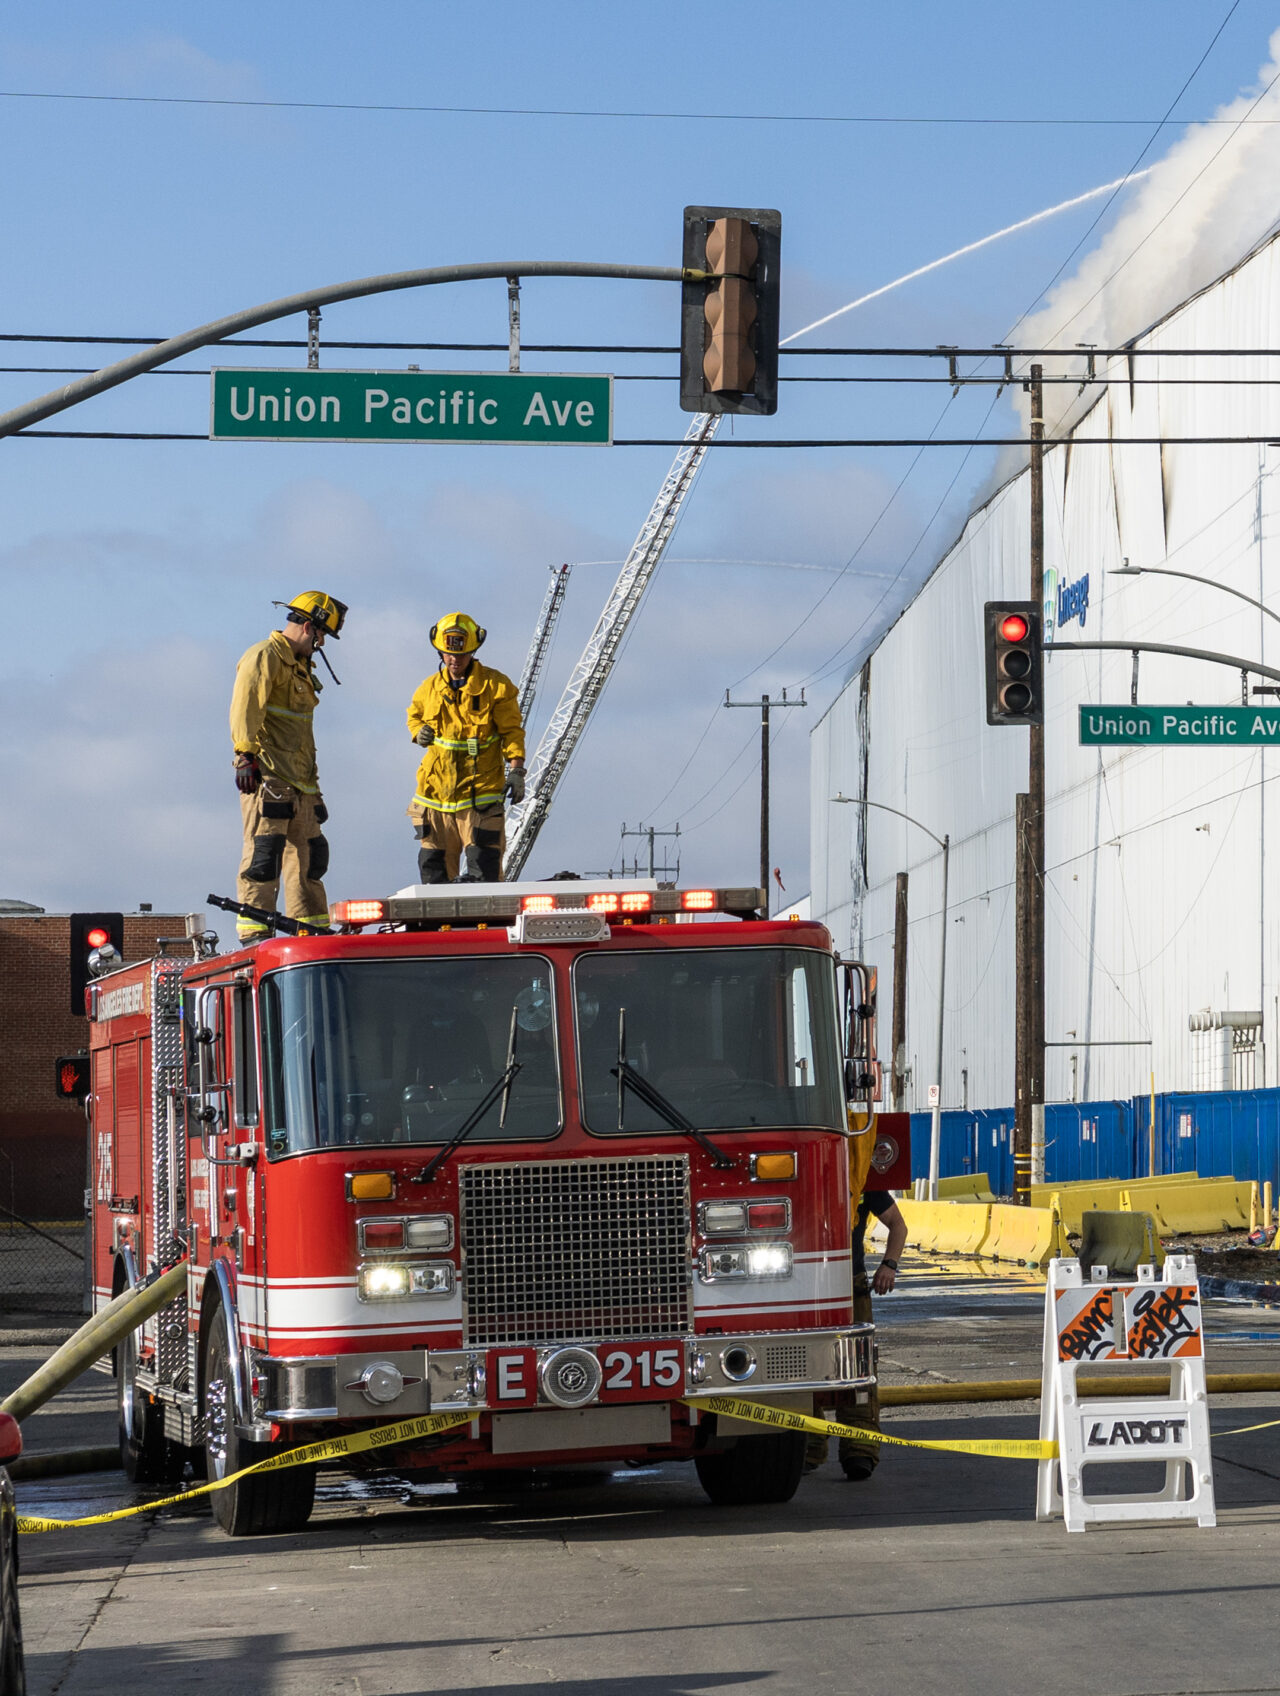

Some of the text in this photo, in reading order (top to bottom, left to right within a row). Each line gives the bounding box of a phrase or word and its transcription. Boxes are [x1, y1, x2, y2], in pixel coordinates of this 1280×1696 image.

[230, 386, 595, 427] Union Pacific Ave
[316, 607, 326, 620] 15
[448, 636, 460, 646] 15
[1089, 715, 1150, 735] Union
[1163, 715, 1237, 735] Pacific
[97, 1131, 113, 1202] 215
[499, 1349, 680, 1399] E 215
[709, 1398, 805, 1428] FIRE LINE DO NOT CROSS
[400, 1422, 415, 1438] NOT
[417, 1419, 428, 1434] DO
[430, 1413, 449, 1431] LINE
[369, 1427, 397, 1445] CROSS
[1088, 1419, 1186, 1446] LADOT
[294, 1448, 307, 1461] DO
[310, 1443, 327, 1459] LINE
[331, 1440, 348, 1455] FIRE
[278, 1453, 294, 1466] NOT
[17, 1518, 43, 1533] CROSS
